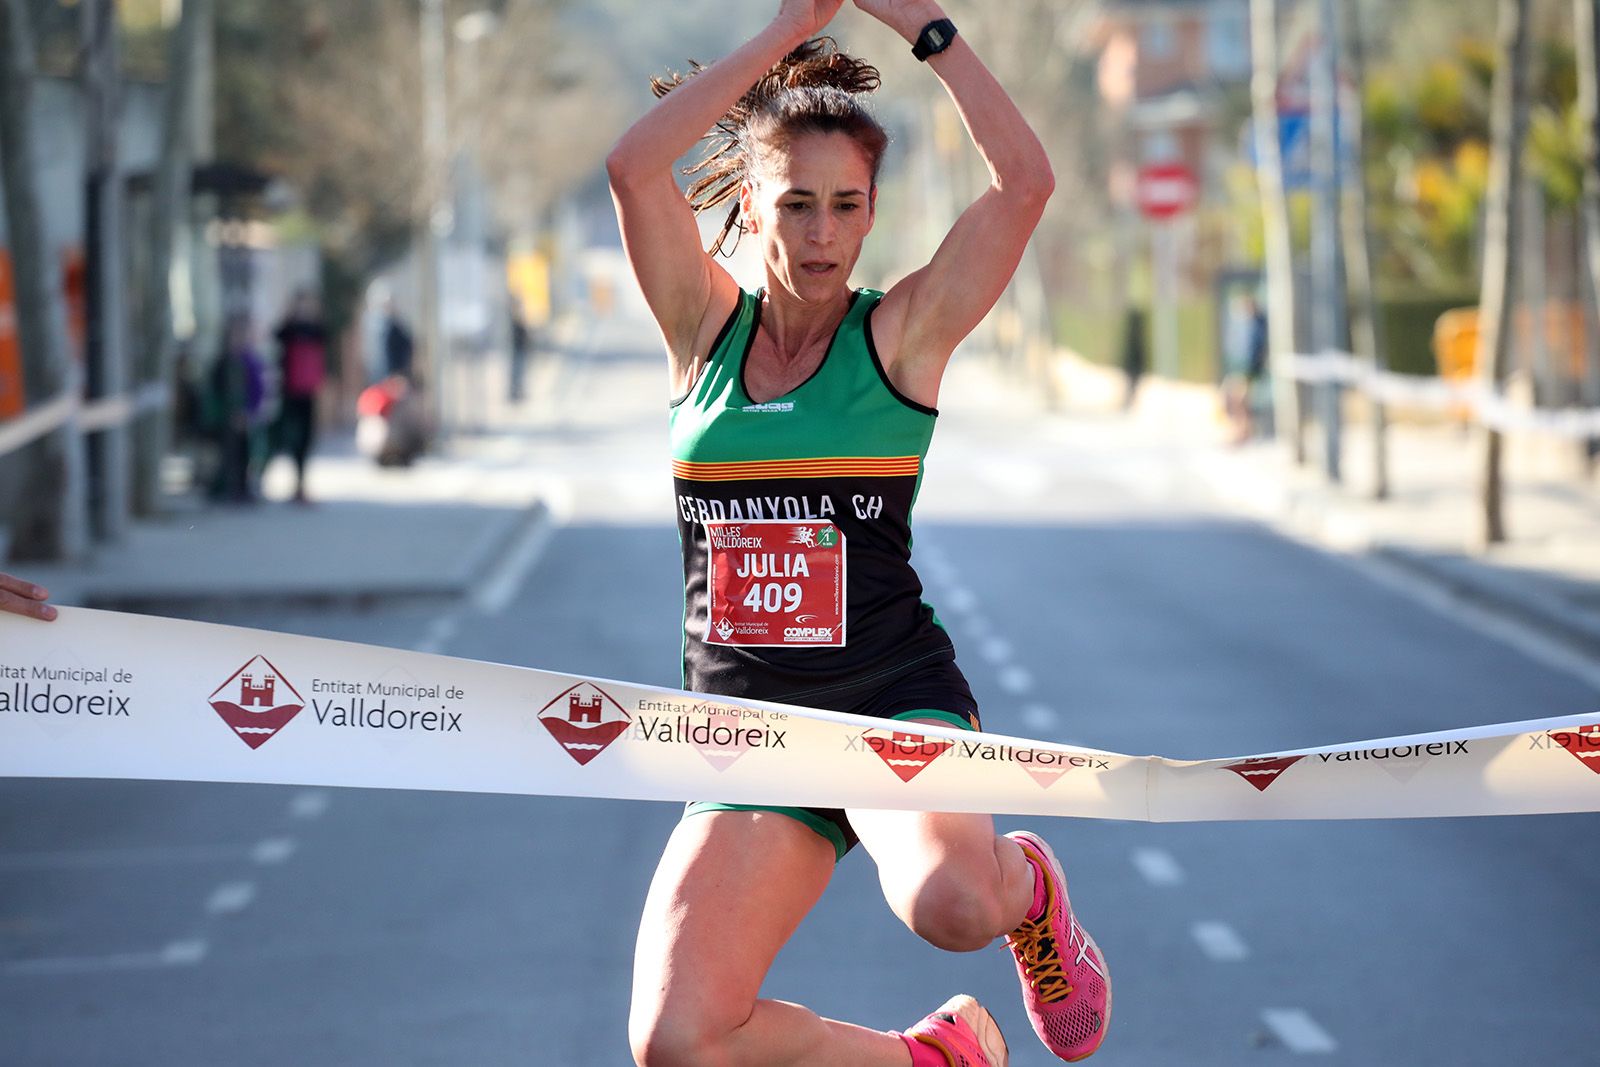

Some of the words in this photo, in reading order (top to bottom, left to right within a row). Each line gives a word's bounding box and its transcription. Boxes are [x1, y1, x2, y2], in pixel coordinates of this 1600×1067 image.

[852, 494, 883, 520] CH
[712, 537, 762, 549] VALLDOREIX
[736, 553, 810, 578] JULIA
[743, 582, 803, 613] 409
[735, 626, 769, 635] Valldoreix
[784, 627, 832, 637] COMPLEX
[0, 664, 27, 679] itat
[31, 666, 107, 685] Municipal
[113, 668, 133, 683] de
[0, 682, 130, 717] alldoreix
[312, 679, 362, 694] Entitat
[367, 682, 439, 701] Municipal
[445, 686, 464, 700] de
[311, 698, 462, 732] Valldoreix
[638, 699, 687, 713] Entitat
[692, 704, 763, 721] Municipal
[769, 711, 789, 721] de
[638, 715, 786, 748] Valldoreix
[962, 740, 1111, 770] Valldoreix
